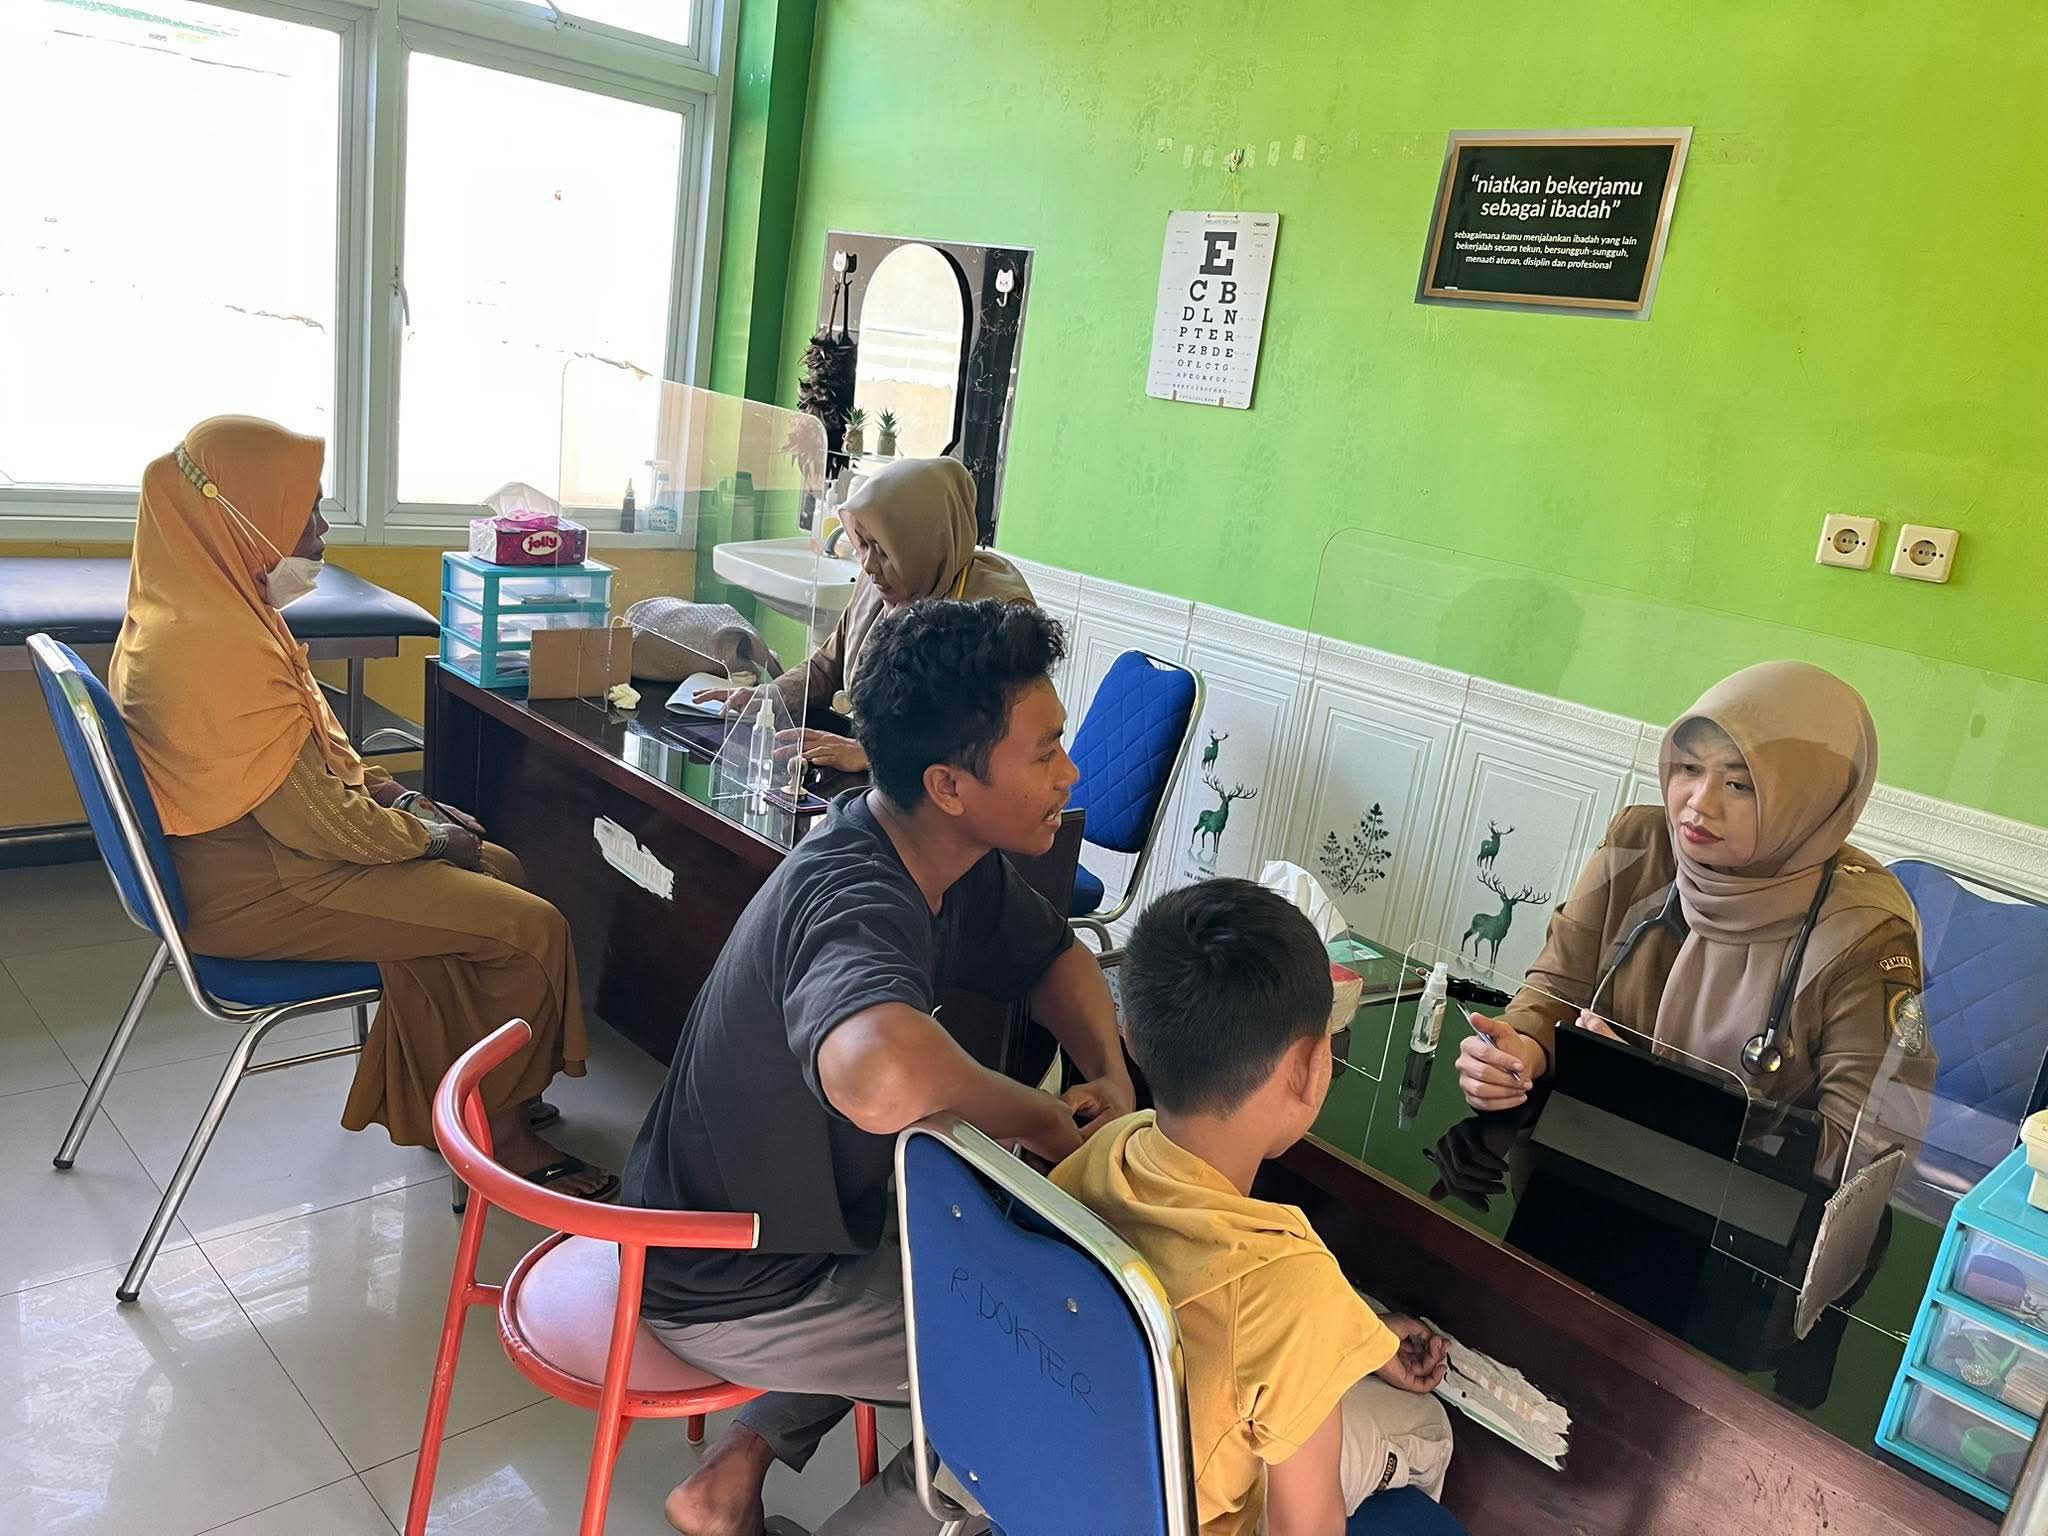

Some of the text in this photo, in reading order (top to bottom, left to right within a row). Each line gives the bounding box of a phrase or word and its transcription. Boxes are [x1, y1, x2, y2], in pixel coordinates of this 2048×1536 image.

[1471, 174, 1643, 198] “niatkan bekerjamu
[1480, 199, 1621, 220] sebagai ibadah”
[1454, 231, 1637, 247] sebagaimana kamu menjalankan ibadah yang lain
[1199, 231, 1237, 276] E
[1456, 242, 1629, 258] bekerjalah secara tekun, bersungguh-sungguh,
[1465, 255, 1612, 270] menaati aturan, disiplin dan profesional
[528, 536, 558, 552] jolly
[951, 1266, 1098, 1415] R DOKTER
